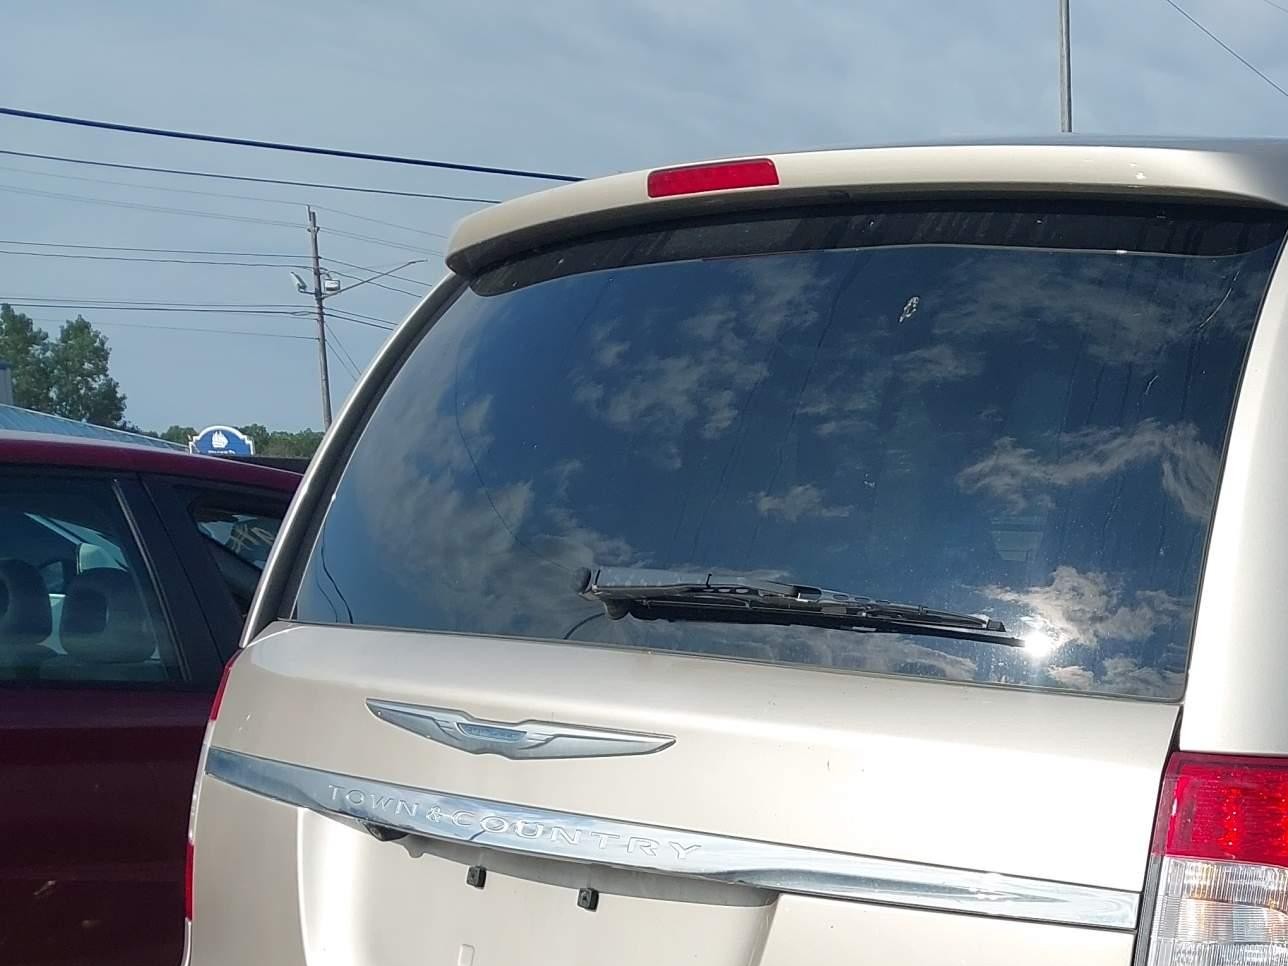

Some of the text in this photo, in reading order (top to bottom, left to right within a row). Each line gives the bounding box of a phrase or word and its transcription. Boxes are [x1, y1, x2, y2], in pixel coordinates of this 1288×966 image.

[328, 784, 702, 861] TOWN & COUNTRY
